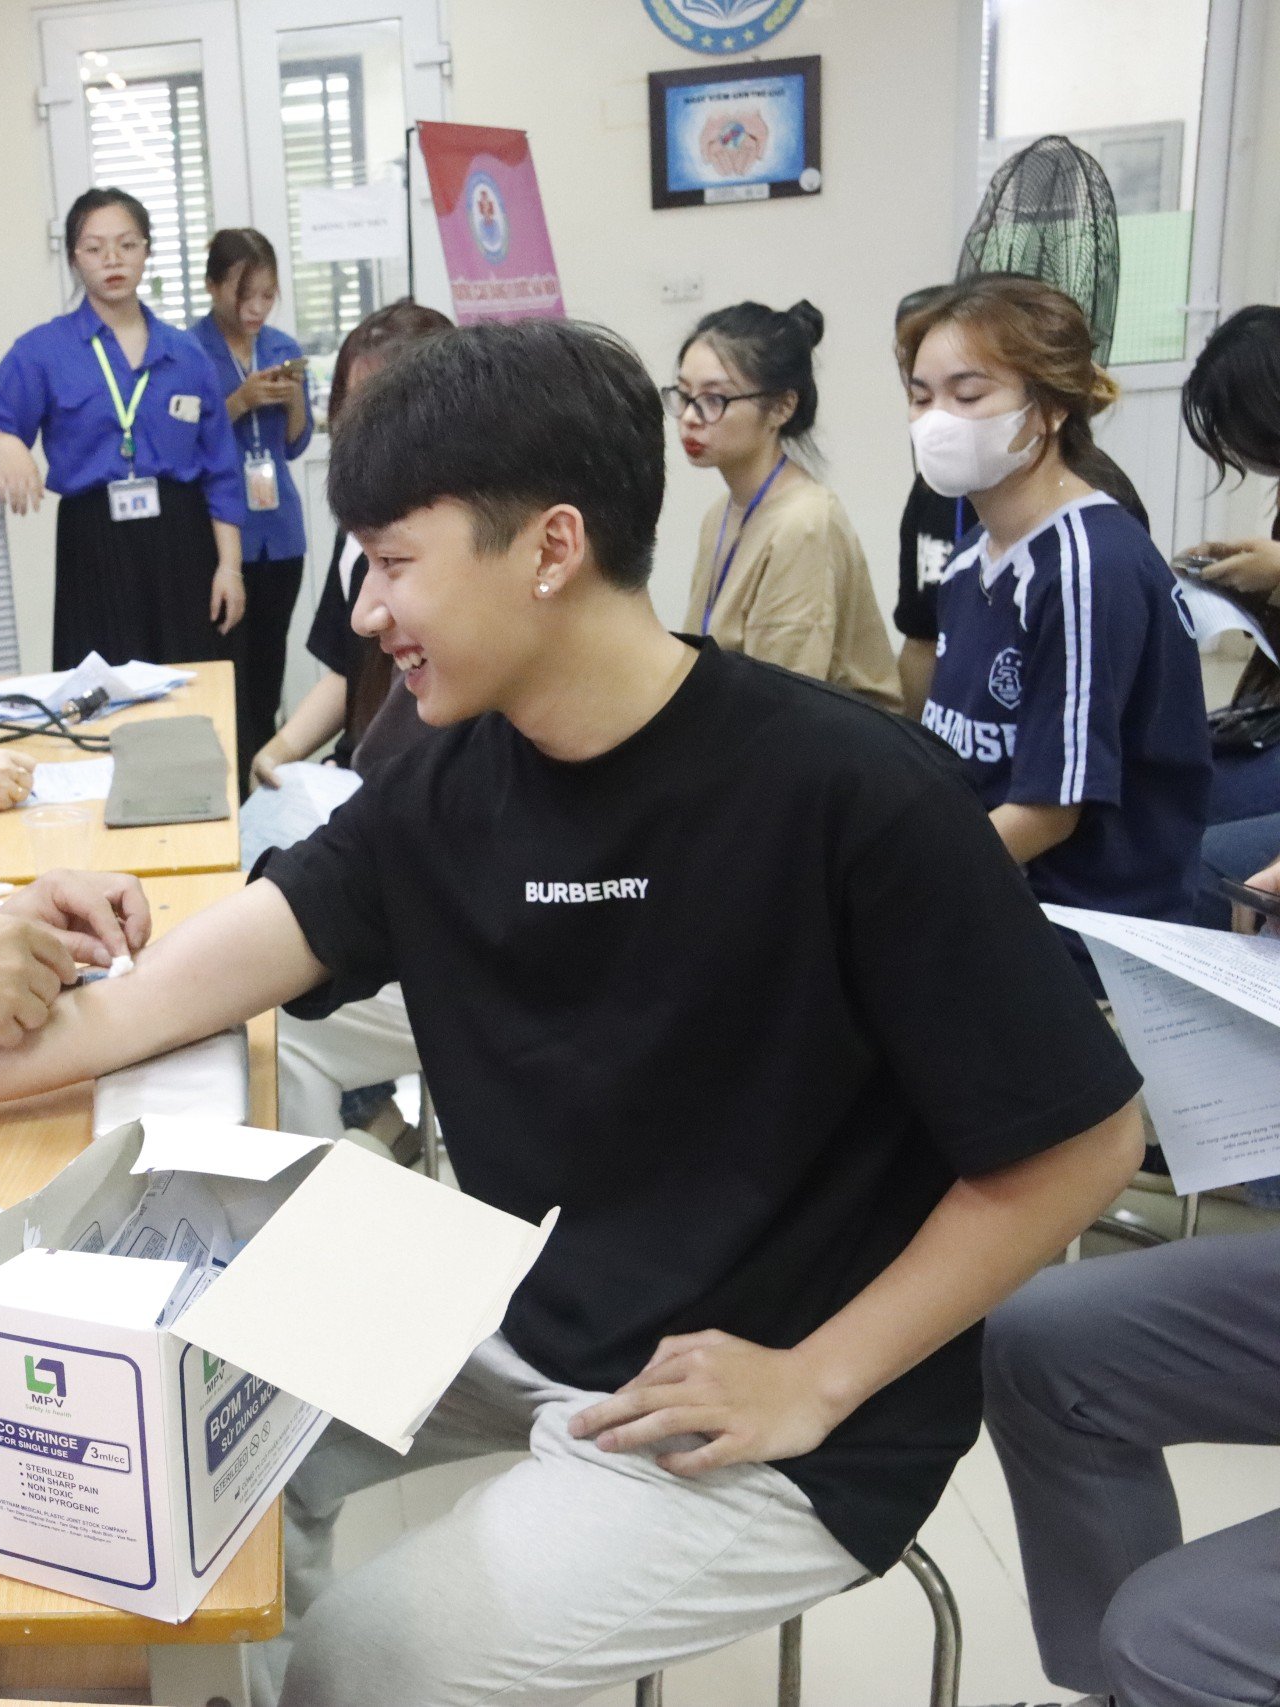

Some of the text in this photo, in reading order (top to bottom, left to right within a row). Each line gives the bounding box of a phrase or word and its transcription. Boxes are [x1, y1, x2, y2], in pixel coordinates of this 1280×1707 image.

[525, 878, 649, 904] BURBERRY
[206, 1368, 225, 1395] MPV
[26, 1403, 44, 1413] Safety
[52, 1409, 72, 1418] health
[31, 1393, 64, 1408] MPV
[236, 1400, 259, 1437] DỤNG
[0, 1435, 68, 1458] FOR SINGLE USE
[18, 1427, 78, 1450] SYRINGE
[90, 1447, 125, 1464] 3ml/cc
[26, 1463, 74, 1481] STERILIZED
[26, 1473, 99, 1495] NON SHARP PAIN
[27, 1482, 73, 1499] NON TOXIC
[28, 1492, 100, 1514] NON PYROGENIC
[21, 1505, 43, 1515] MEDICAL
[44, 1510, 64, 1520] PLASTIC
[66, 1516, 81, 1524] JOINT
[83, 1520, 100, 1529] STOCK
[101, 1524, 128, 1534] COMPANY
